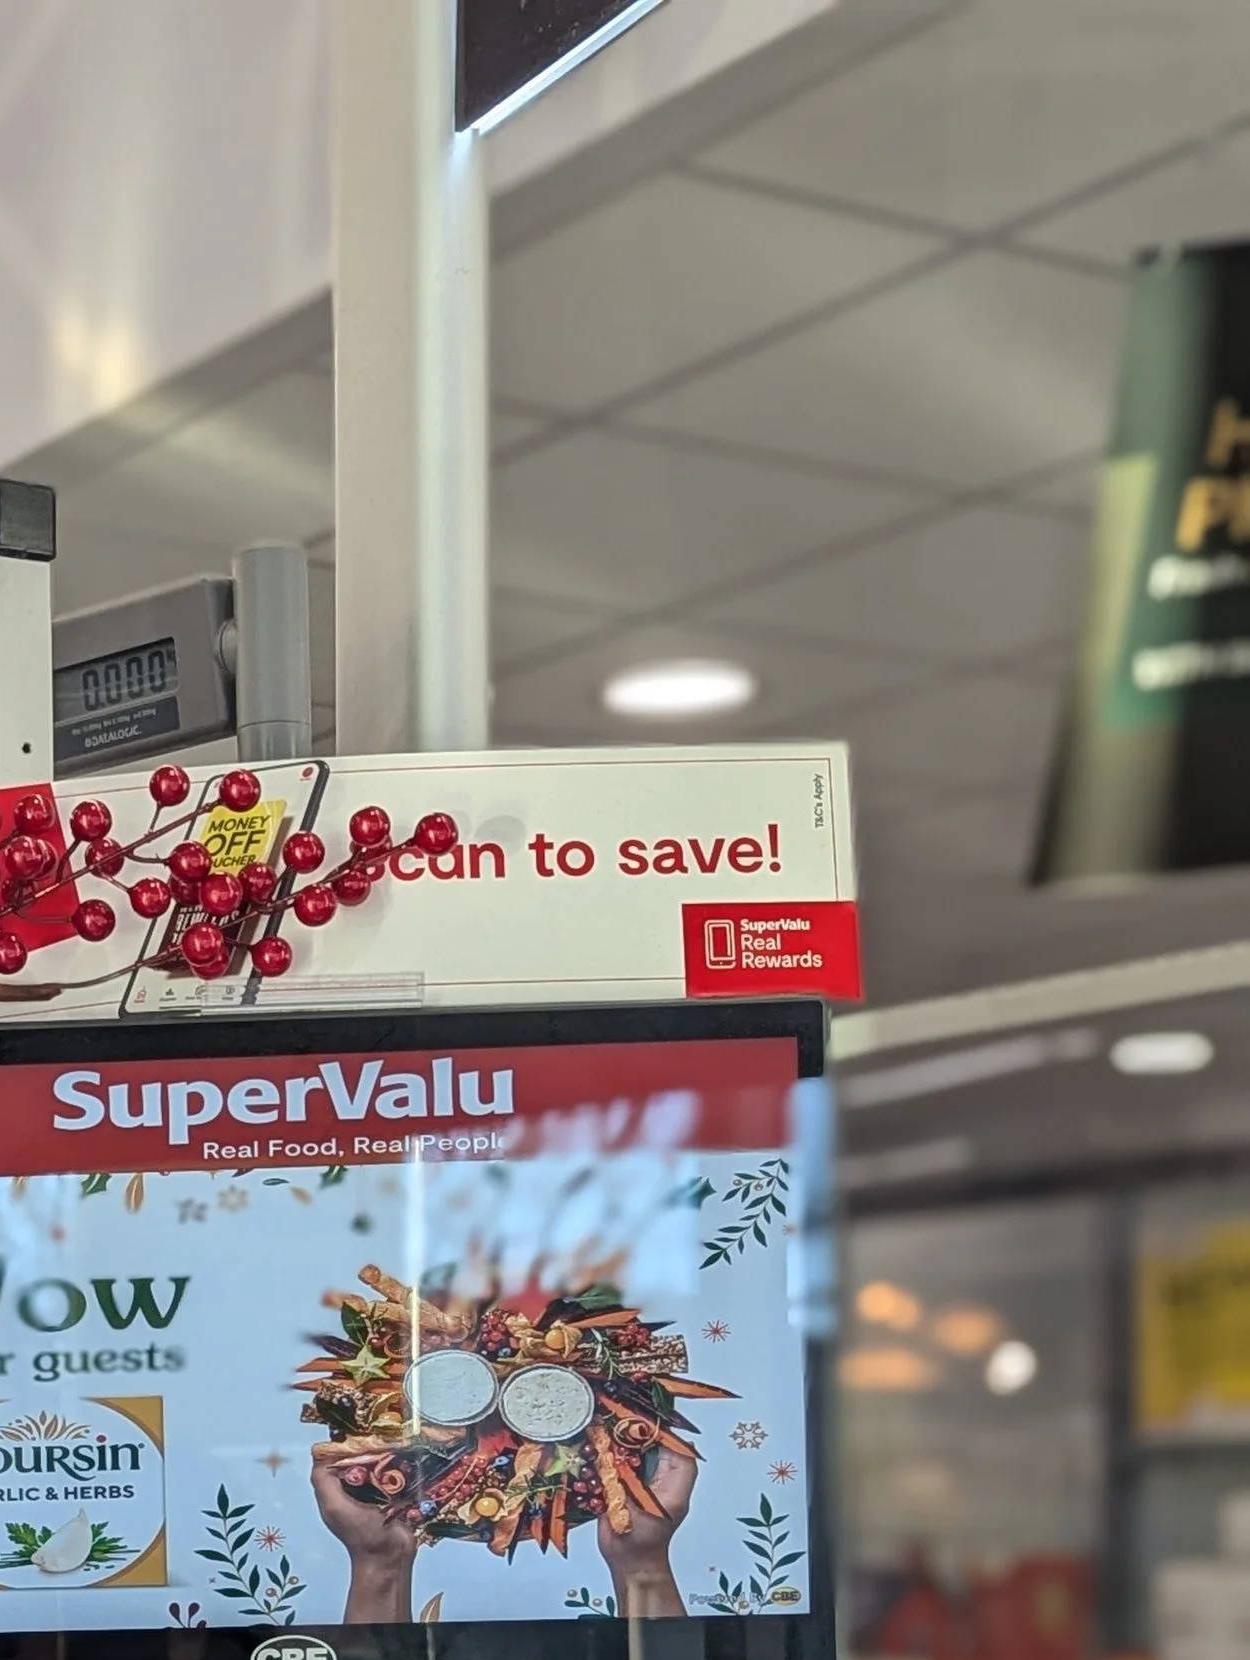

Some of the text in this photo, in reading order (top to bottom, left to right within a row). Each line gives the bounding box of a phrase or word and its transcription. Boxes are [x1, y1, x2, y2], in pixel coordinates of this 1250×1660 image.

[81, 649, 158, 712] 0.000
[207, 815, 271, 833] MONEY
[203, 830, 267, 858] OFF
[367, 823, 782, 882] can to save!
[211, 855, 256, 869] UCHER
[740, 918, 811, 935] SuperValu
[740, 933, 782, 951] Real
[741, 950, 823, 969] Rewards
[53, 1057, 515, 1146] SuperValu
[203, 1139, 259, 1160] Real
[268, 1137, 345, 1159] Food,
[354, 1135, 410, 1155] Real
[32, 1342, 188, 1382] guests
[44, 1486, 60, 1501] &
[63, 1484, 135, 1500] HERBS
